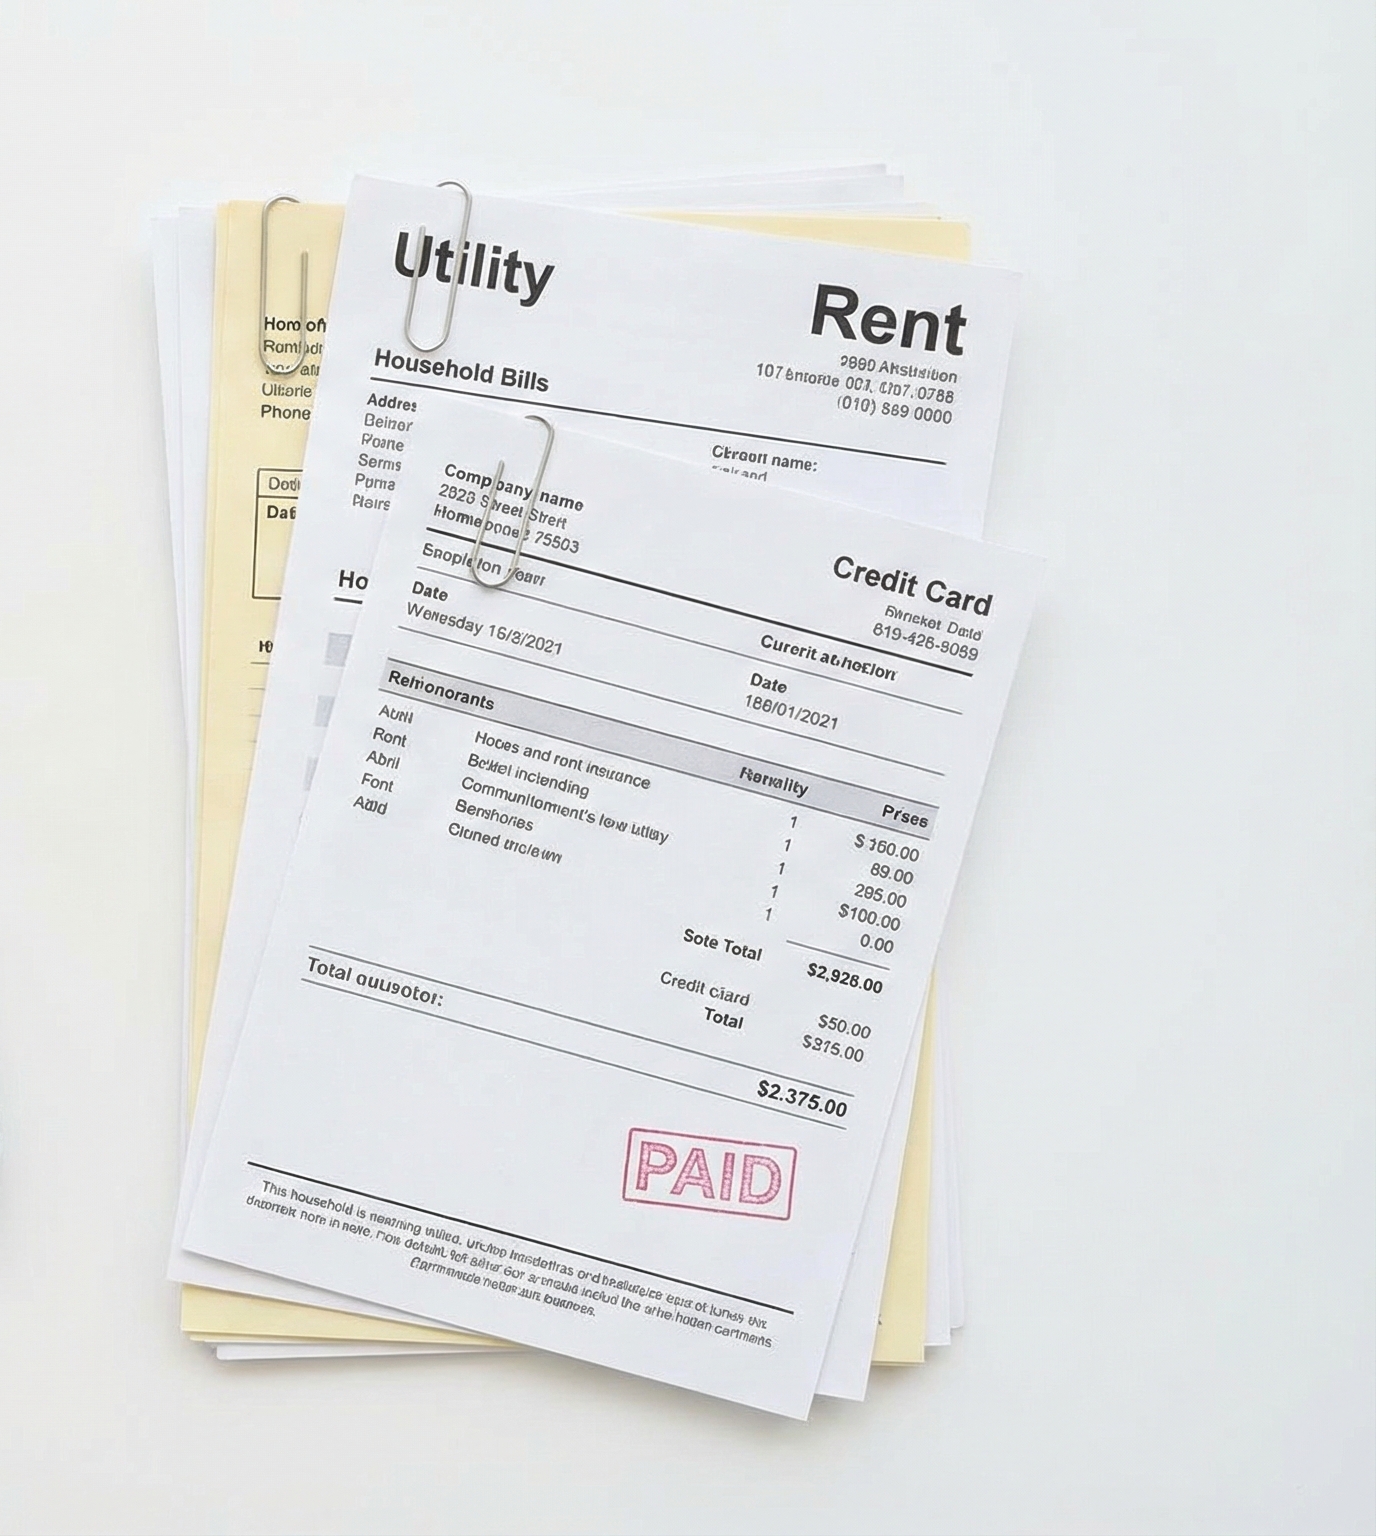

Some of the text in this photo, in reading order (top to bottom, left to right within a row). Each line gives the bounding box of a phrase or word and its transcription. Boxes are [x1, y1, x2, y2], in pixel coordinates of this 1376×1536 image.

[394, 231, 554, 307] Utility
[810, 283, 968, 357] Rent
[375, 348, 550, 392] Household Bills
[261, 404, 311, 420] Phone
[914, 407, 952, 424] 0000
[771, 455, 818, 473] name:
[540, 490, 584, 512] name
[338, 569, 369, 590] Ho
[412, 581, 448, 601] Date
[833, 556, 993, 616] Credit Card
[750, 673, 787, 694] Date
[372, 727, 408, 747] Ront
[523, 743, 552, 762] and
[361, 773, 394, 793] Font
[870, 862, 914, 885] 89.00
[838, 903, 901, 932] $100.00
[683, 928, 763, 961] Sote Total
[860, 933, 894, 954] 0.00
[308, 956, 352, 982] Total
[660, 971, 705, 995] Credit
[704, 1006, 744, 1030] Total
[818, 1014, 872, 1039] $50.00
[757, 1079, 848, 1117] $2.375.00
[636, 1140, 782, 1206] PAID
[263, 1180, 287, 1198] This
[290, 1189, 354, 1216] household
